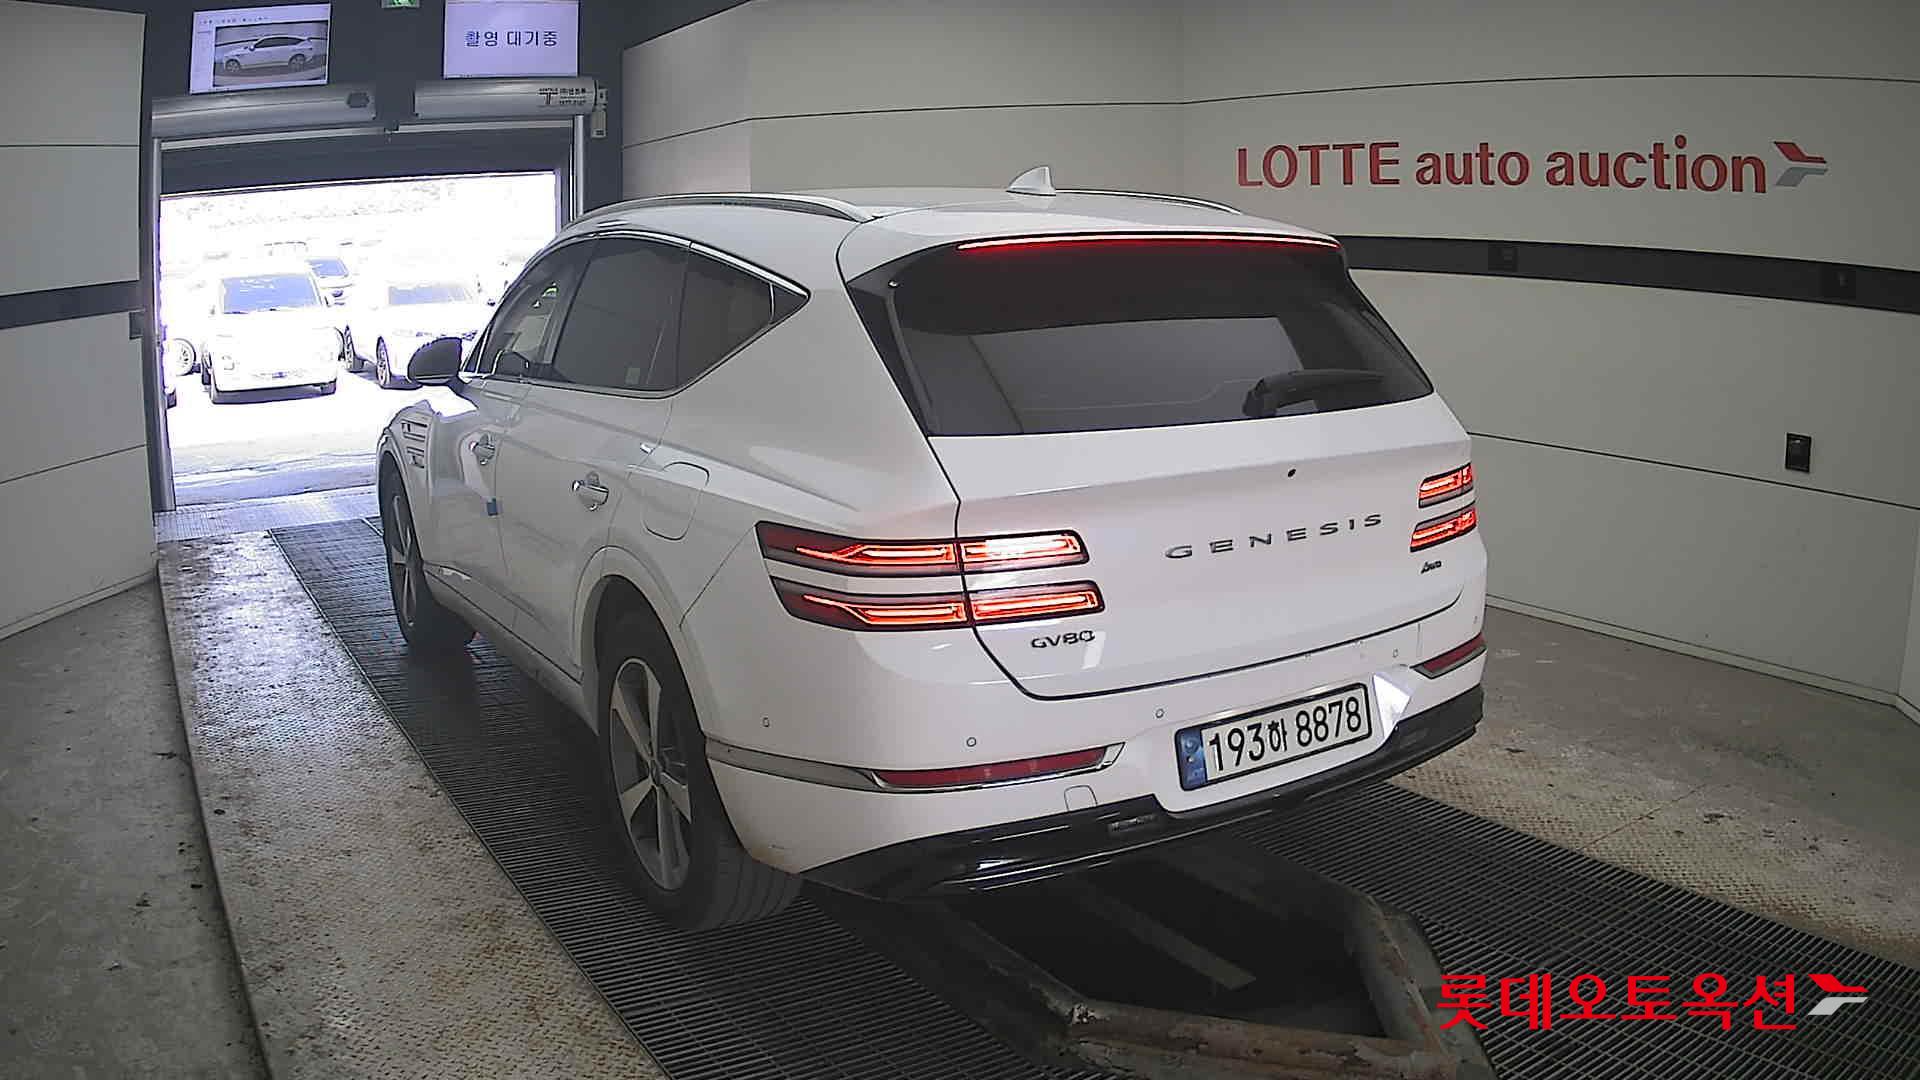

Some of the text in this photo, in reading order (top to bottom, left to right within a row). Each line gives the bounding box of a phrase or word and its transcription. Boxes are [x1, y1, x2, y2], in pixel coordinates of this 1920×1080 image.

[507, 31, 557, 46] 대기중
[1237, 134, 1767, 193] LOTTE auto auction
[1165, 514, 1382, 559] GENESIS
[1031, 630, 1096, 648] GV80
[1208, 696, 1362, 772] 193하 8878
